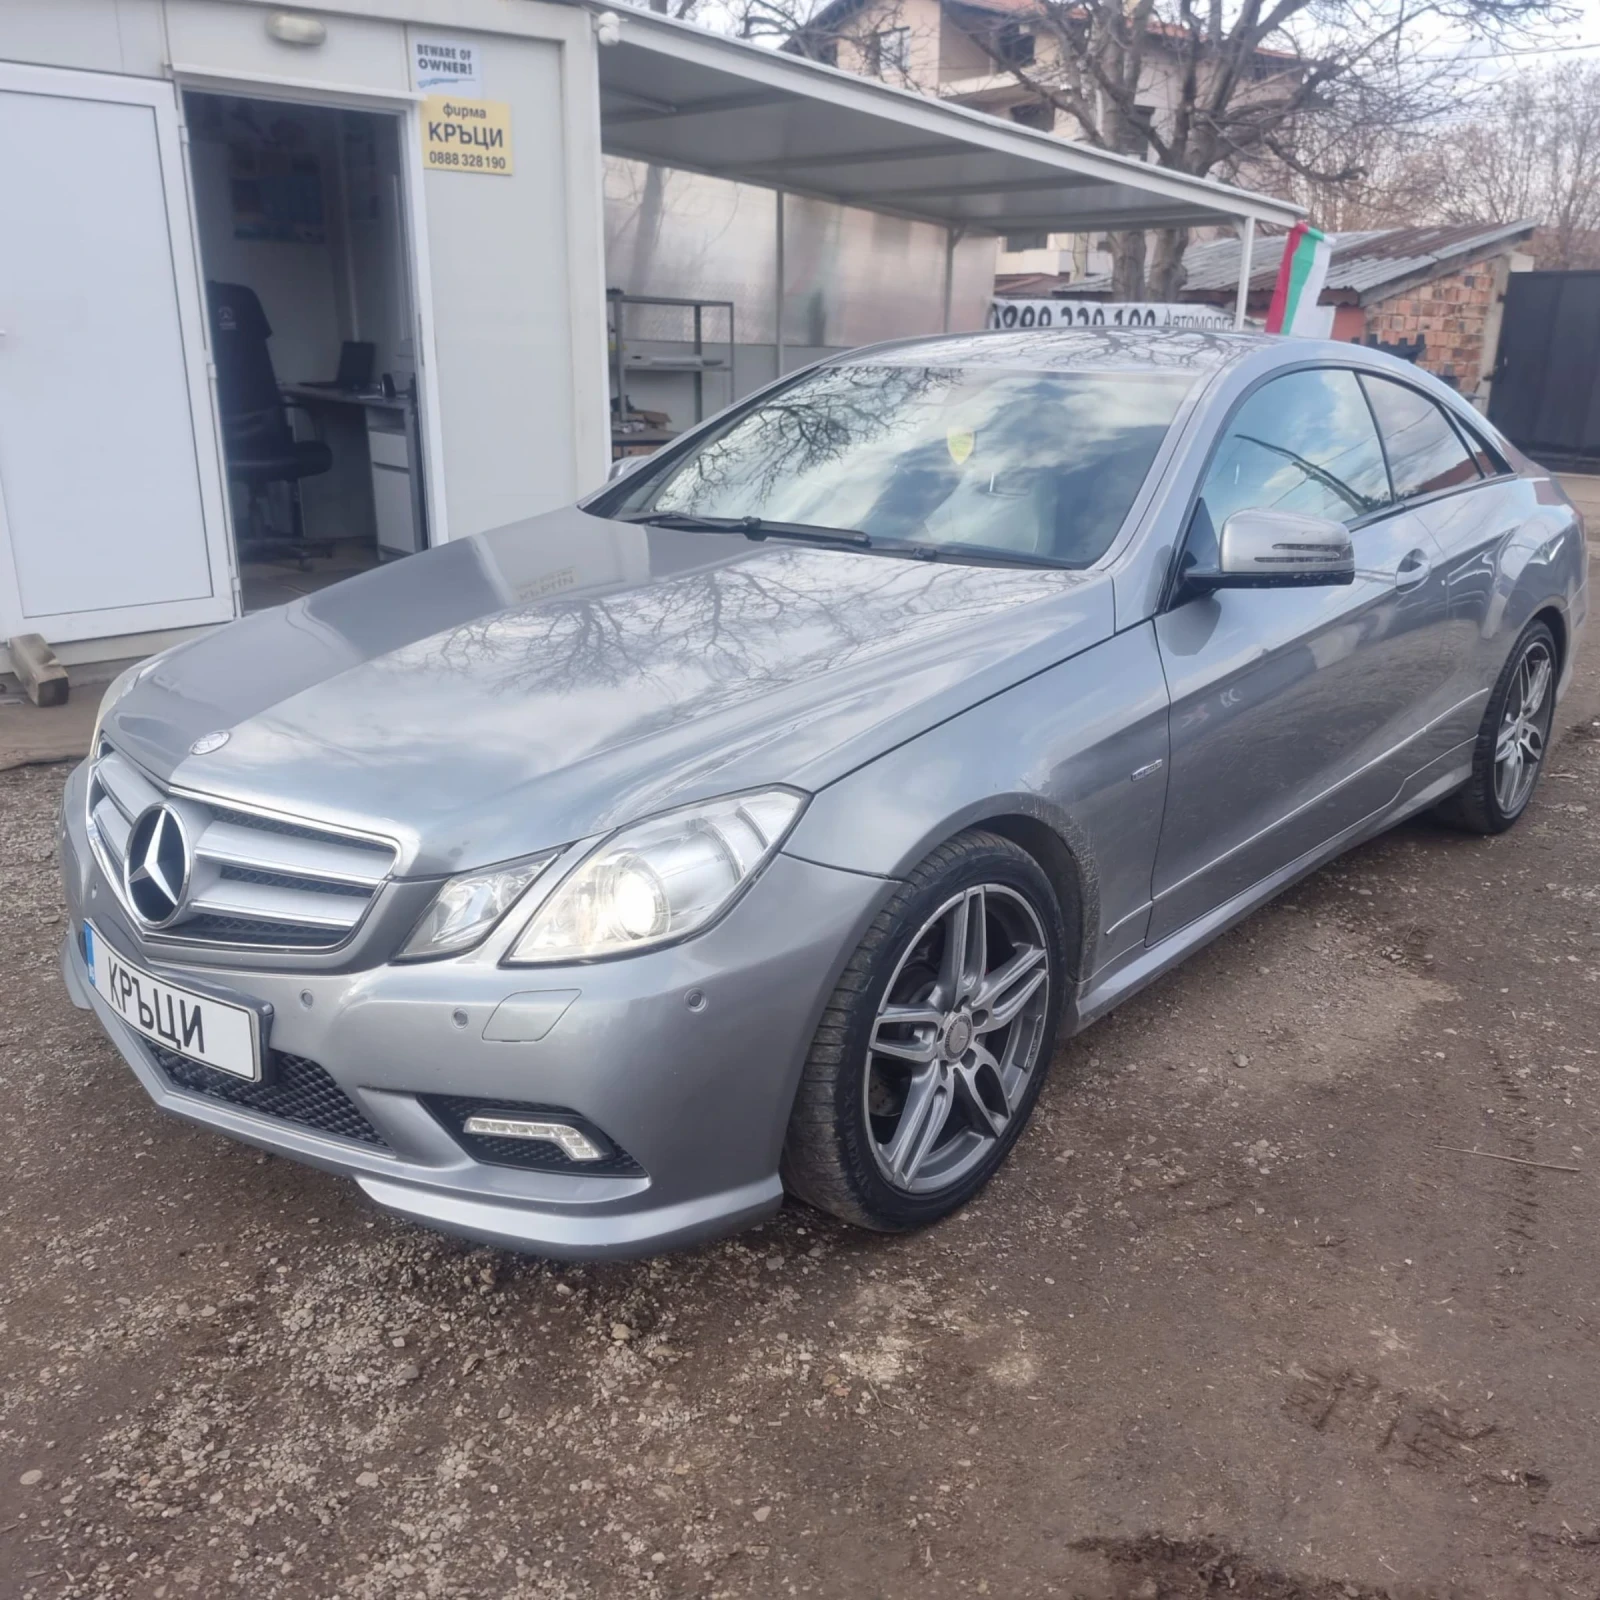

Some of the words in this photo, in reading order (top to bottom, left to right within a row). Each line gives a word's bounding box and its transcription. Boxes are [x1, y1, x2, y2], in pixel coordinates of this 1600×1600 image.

[417, 43, 456, 60] BEWARE
[460, 49, 472, 61] OF
[418, 58, 472, 75] OWNER!
[428, 121, 503, 150] КРЪЦИ
[429, 151, 459, 166] 0888
[461, 153, 483, 168] 328
[485, 156, 506, 170] 190
[108, 956, 205, 1054] КРЪЦИ
